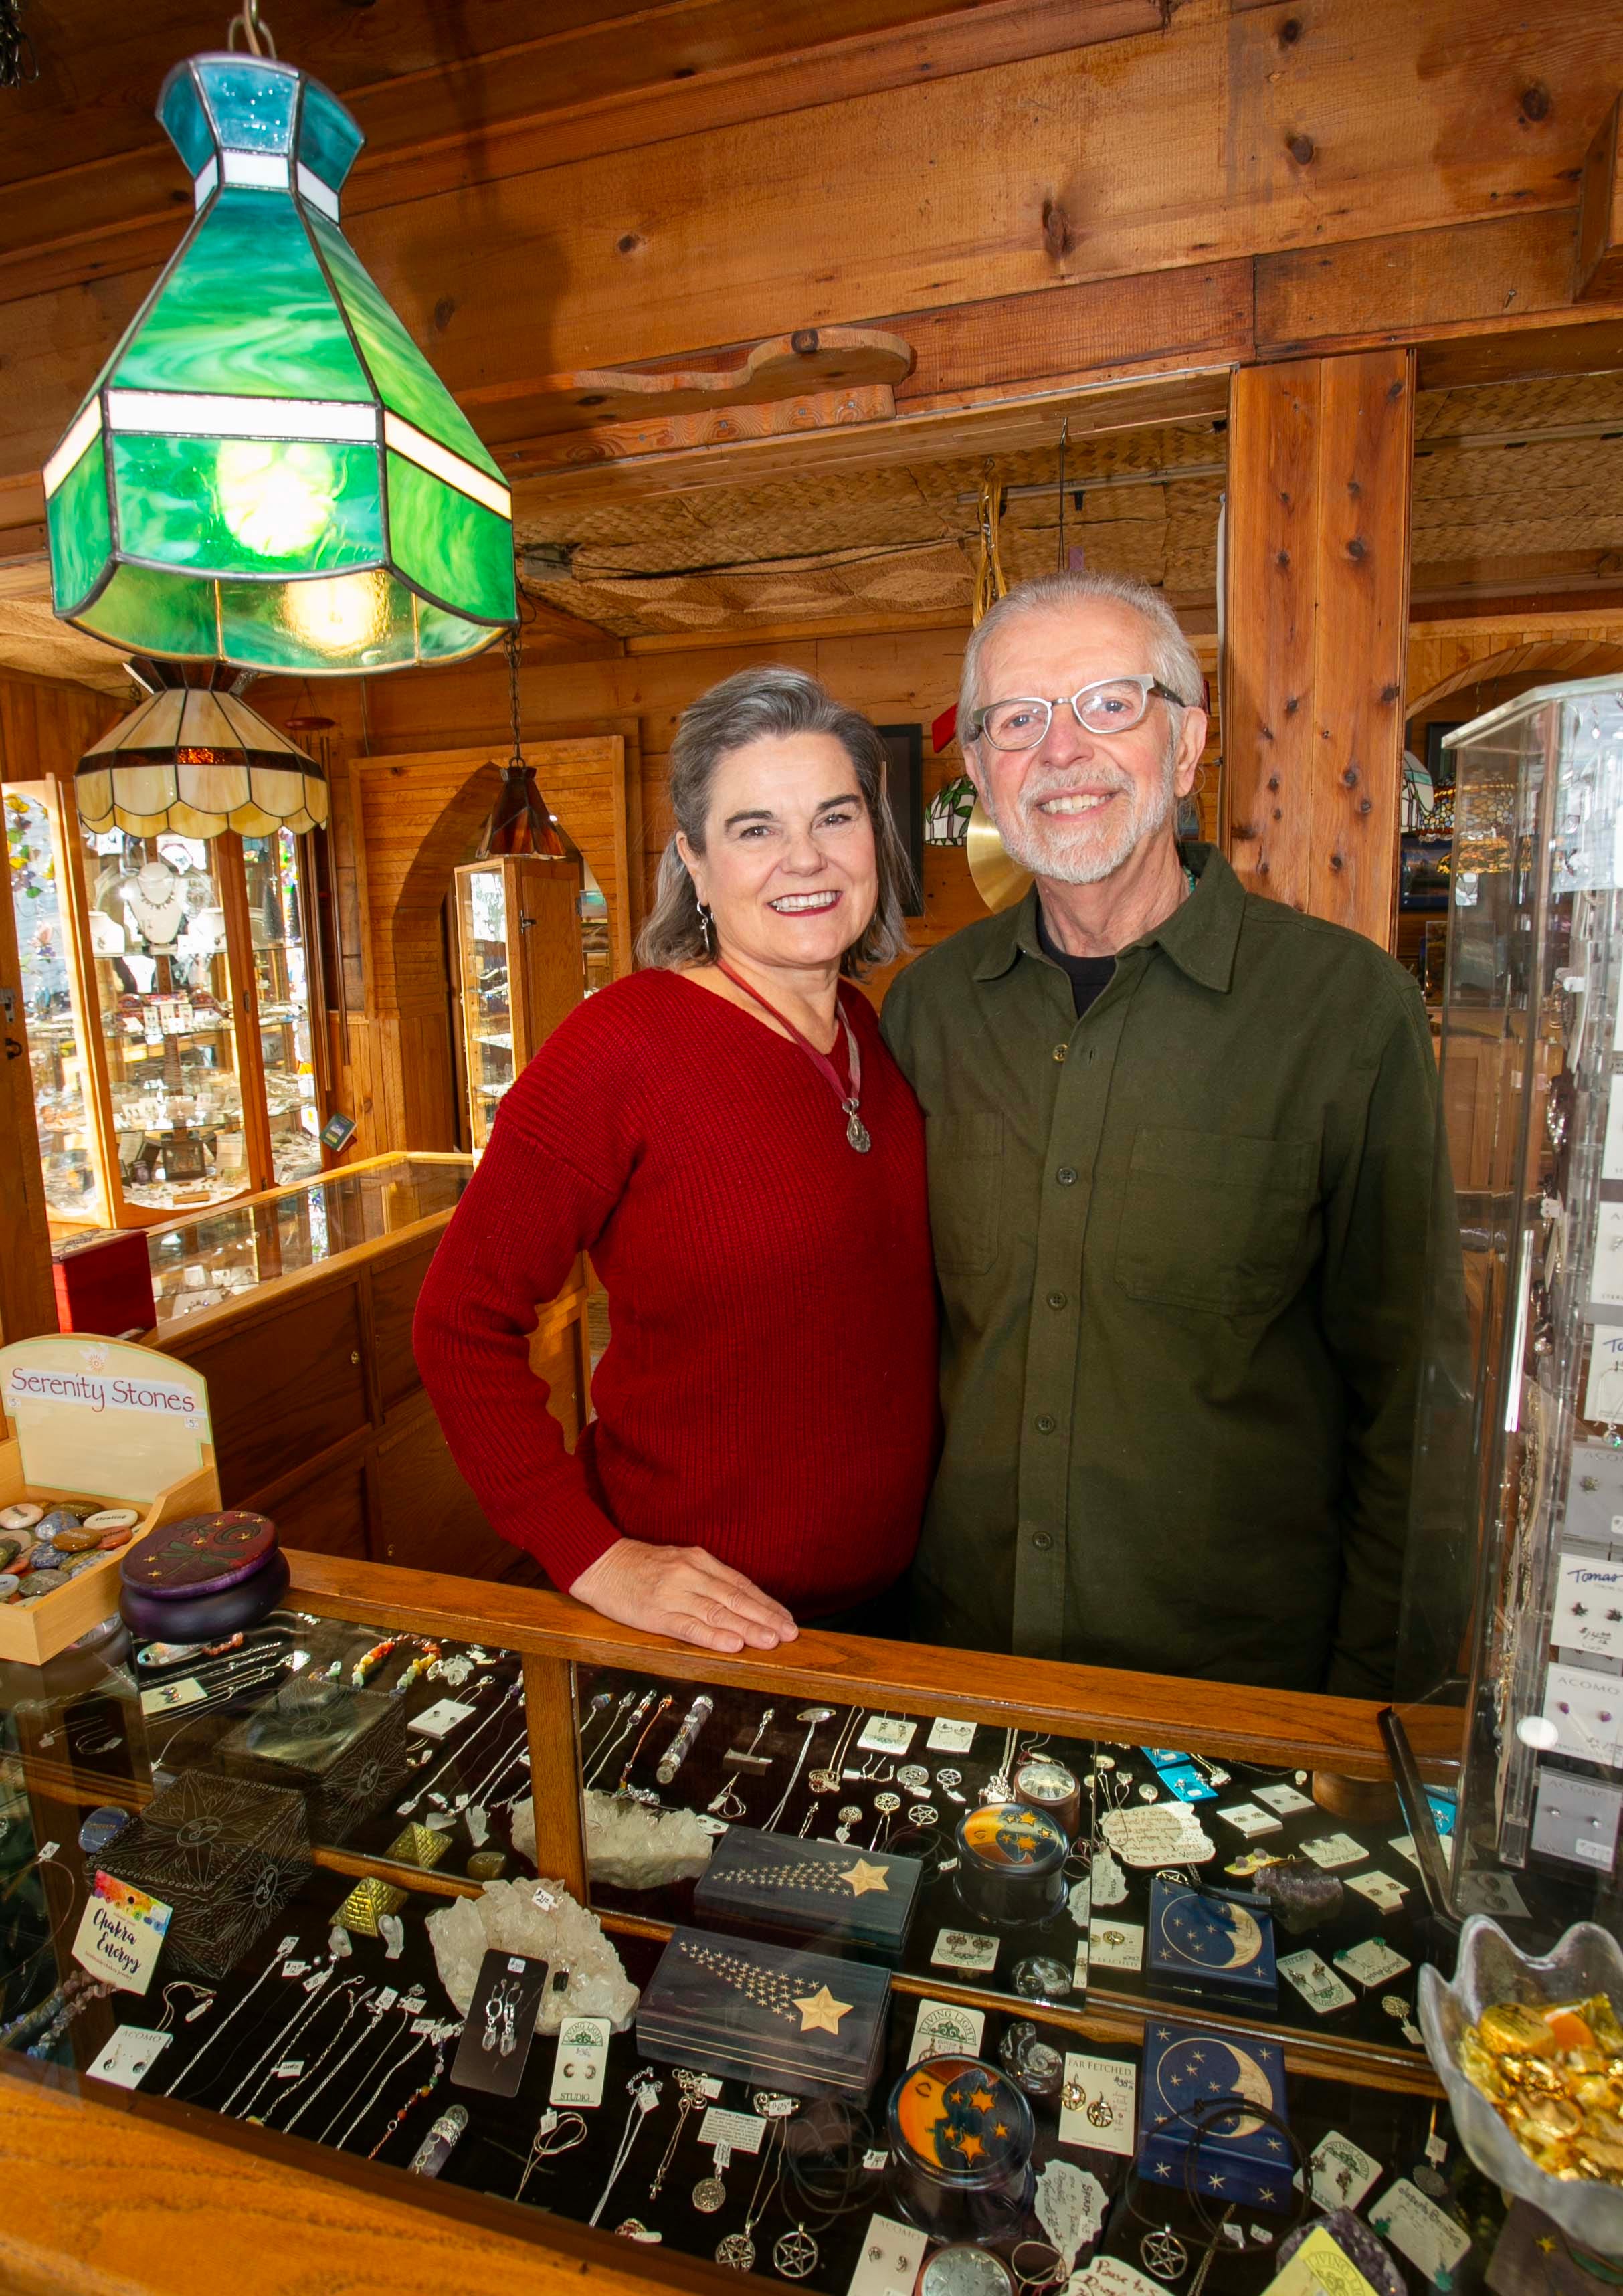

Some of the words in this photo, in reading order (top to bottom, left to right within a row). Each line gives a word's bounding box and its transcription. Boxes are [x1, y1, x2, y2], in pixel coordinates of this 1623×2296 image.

[11, 1368, 106, 1412] Serenity
[112, 1380, 195, 1412] Stones
[1557, 1676, 1622, 1696] ACOMO
[93, 1908, 137, 1945] Chakra
[96, 1932, 141, 1974] Energy
[121, 2030, 161, 2042] ACOMO
[563, 2022, 585, 2044] LIVING
[921, 2010, 952, 2033] LIVING
[954, 2011, 975, 2044] LIGHT
[1068, 2058, 1086, 2069] FAR
[1087, 2062, 1132, 2076] FETCHED
[561, 2091, 590, 2101] STUDIO
[878, 2220, 921, 2242] ACOMO
[1096, 2260, 1129, 2284] Pause
[1133, 2279, 1145, 2293] to
